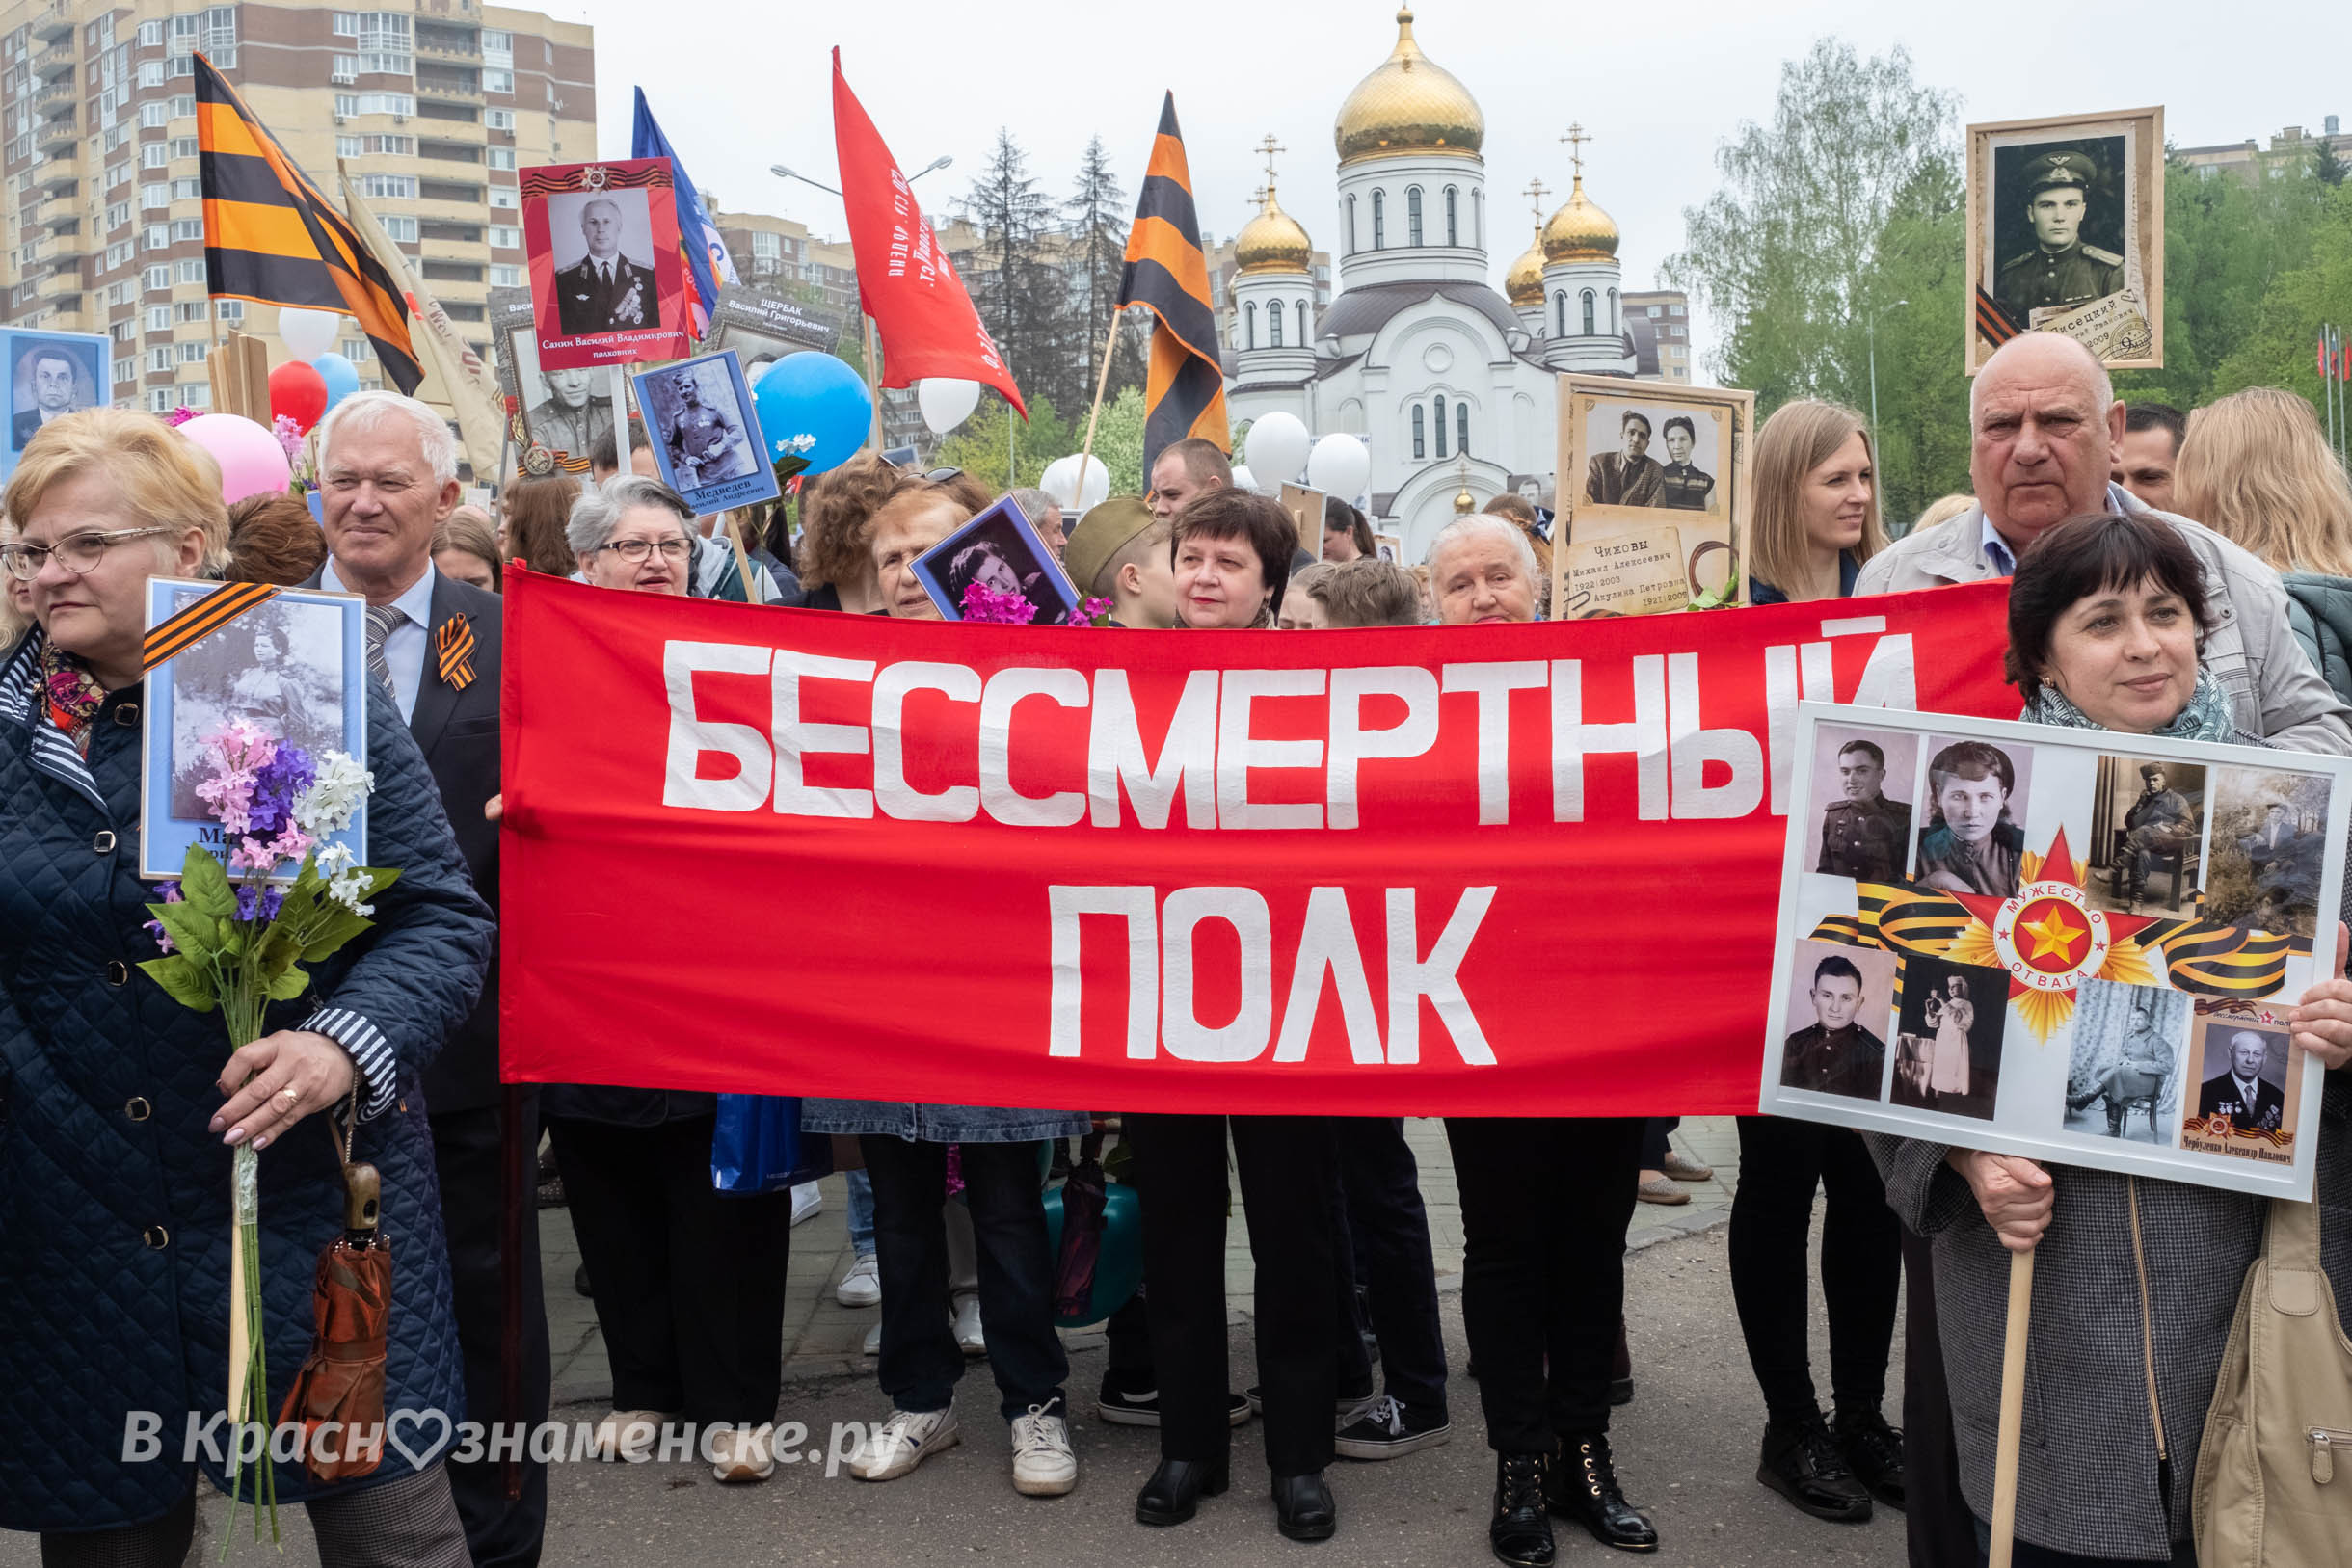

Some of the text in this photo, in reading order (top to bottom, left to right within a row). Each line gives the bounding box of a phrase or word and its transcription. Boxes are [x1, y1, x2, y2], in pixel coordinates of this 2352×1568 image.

[728, 299, 768, 317] Василий
[770, 310, 830, 332] Григорьевич
[761, 298, 803, 316] ЩЕРБАК
[542, 331, 684, 350] Санин Василий Владимирович
[593, 347, 638, 359] полковник
[691, 485, 765, 510] асилий Андреевич
[695, 480, 752, 501] Медведев
[1572, 552, 1671, 578] Михаил Алексеевич
[1594, 577, 1686, 602] Акулина Петровна
[2006, 885, 2102, 924] МУЖЕСТО
[1048, 885, 1499, 1066] ПОЛК
[2012, 961, 2089, 989] ОТВАГА
[2224, 1141, 2258, 1160] Александр
[2258, 1147, 2291, 1163] Павлович
